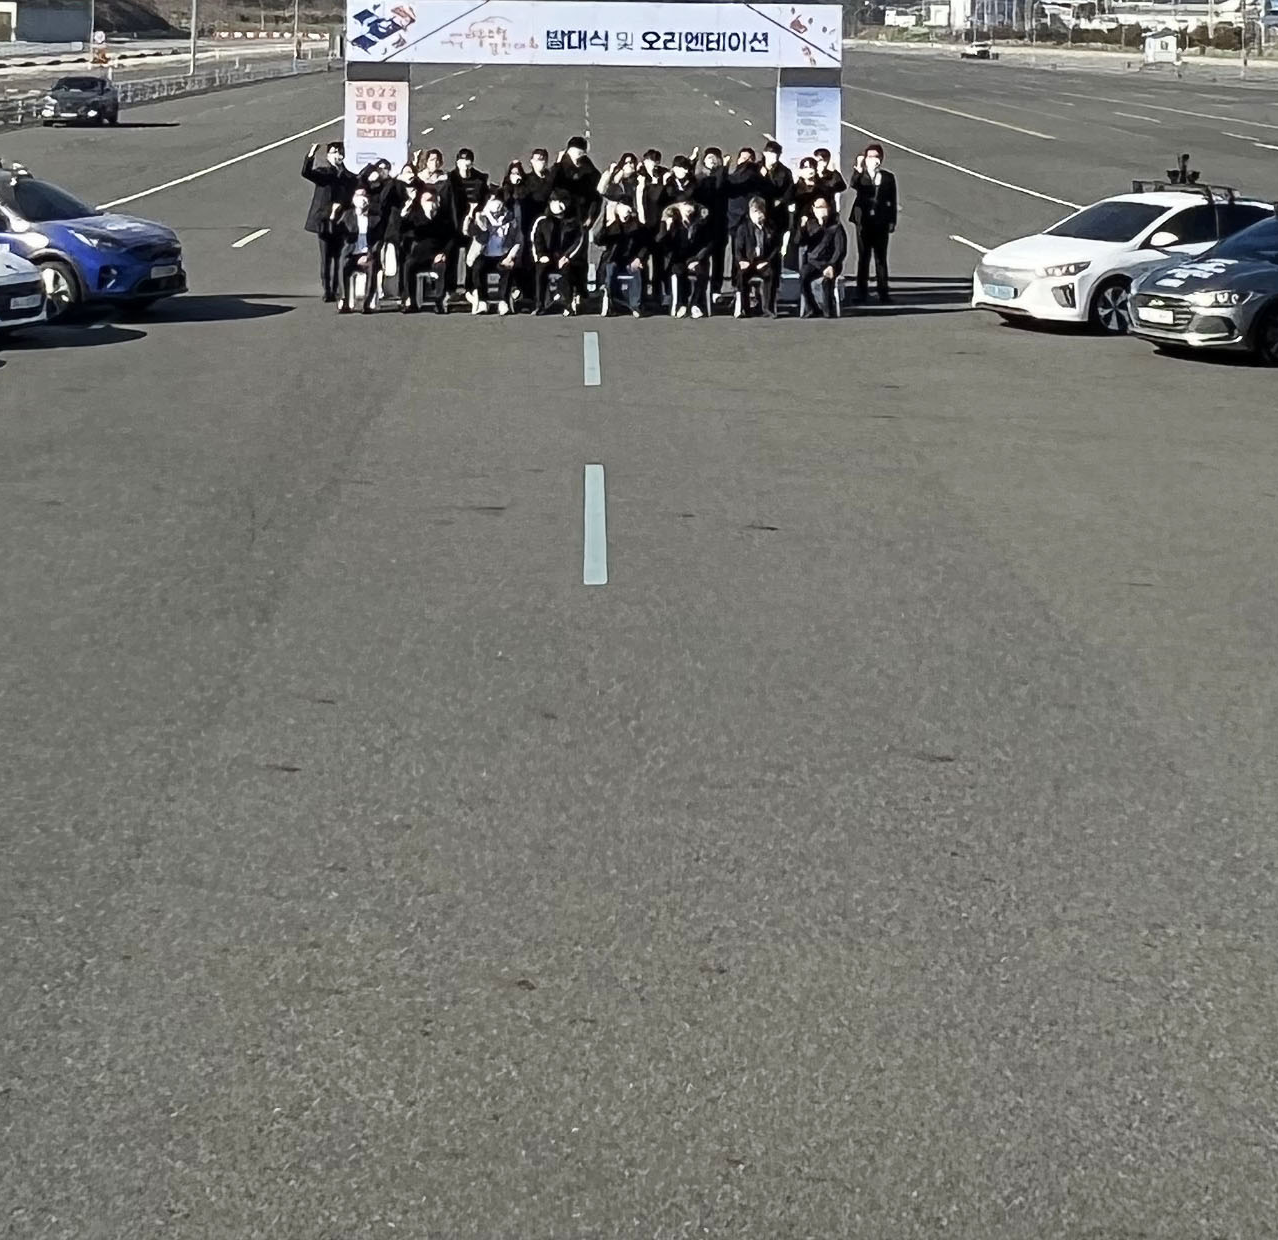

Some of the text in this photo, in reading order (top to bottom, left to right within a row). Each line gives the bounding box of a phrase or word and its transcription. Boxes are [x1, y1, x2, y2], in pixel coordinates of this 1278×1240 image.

[546, 29, 609, 51] 발대식
[616, 31, 634, 51] 및
[640, 31, 769, 52] 오리엔테이션
